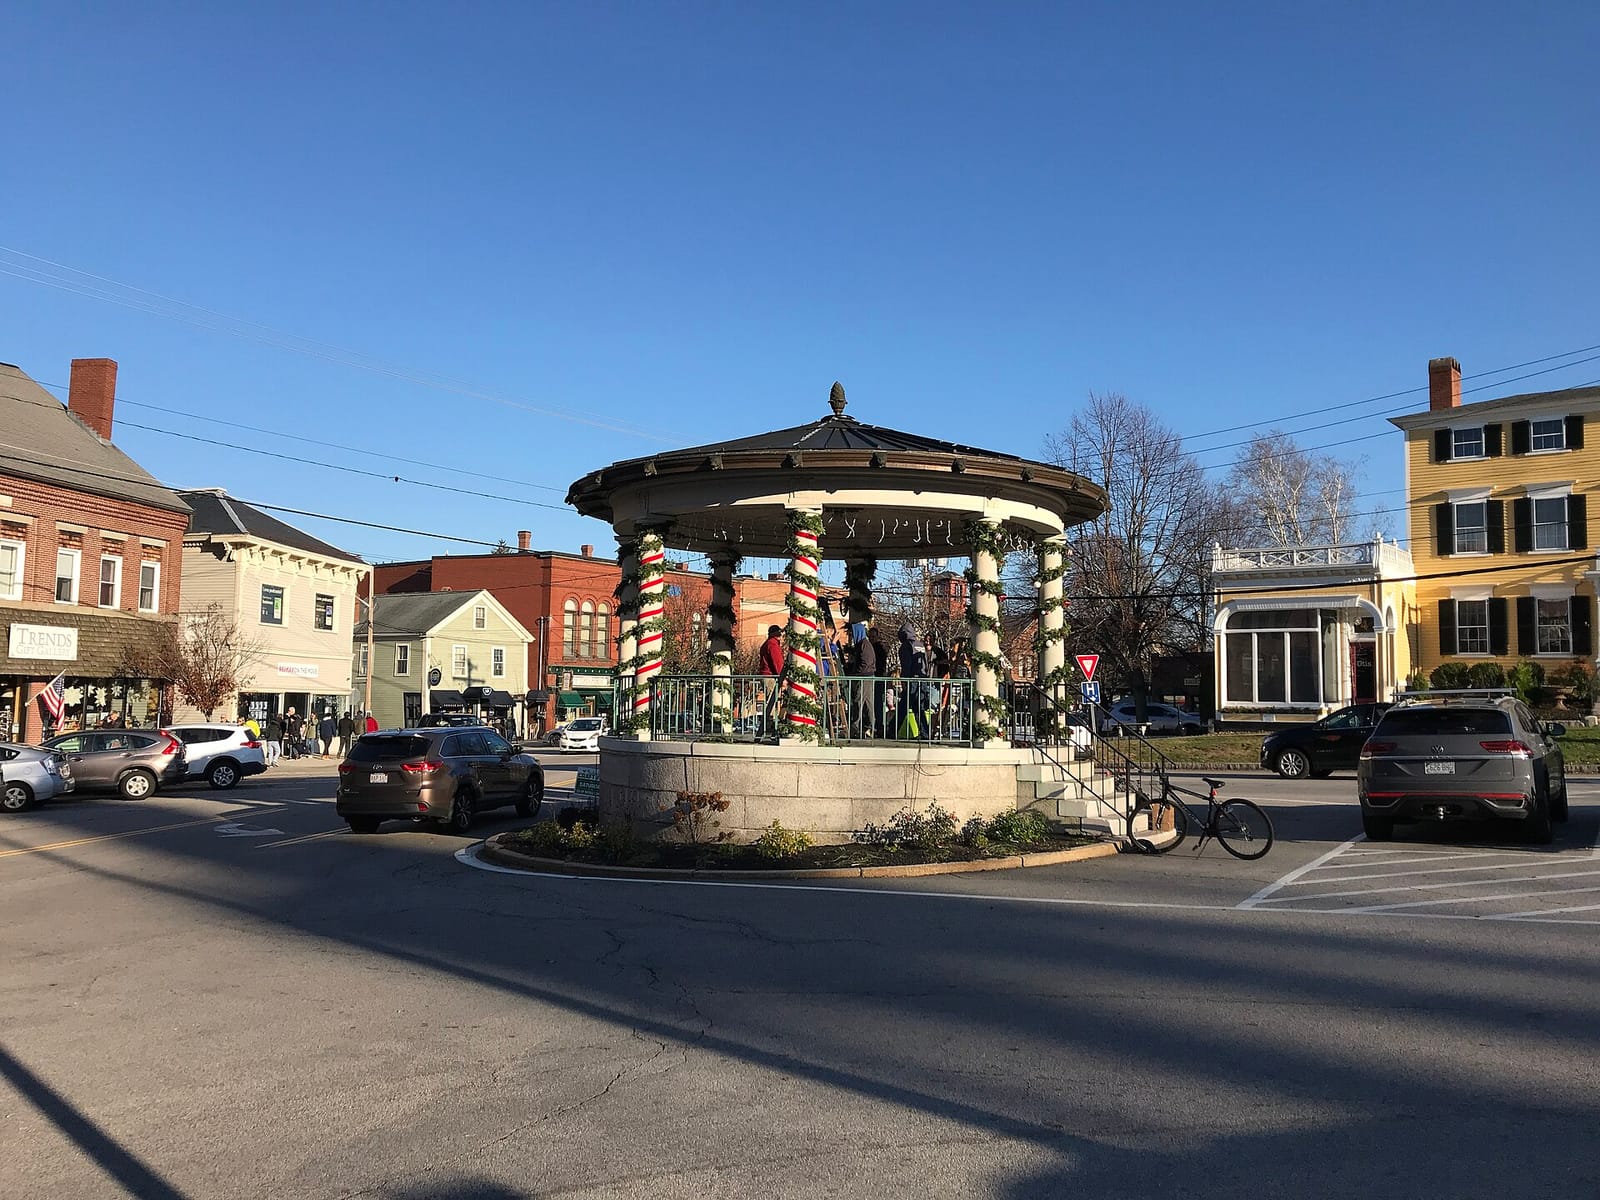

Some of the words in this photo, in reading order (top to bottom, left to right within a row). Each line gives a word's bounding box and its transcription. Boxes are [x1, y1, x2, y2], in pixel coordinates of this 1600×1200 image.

[17, 627, 72, 648] TRENDS
[16, 644, 35, 655] GIFT
[1086, 683, 1095, 696] H
